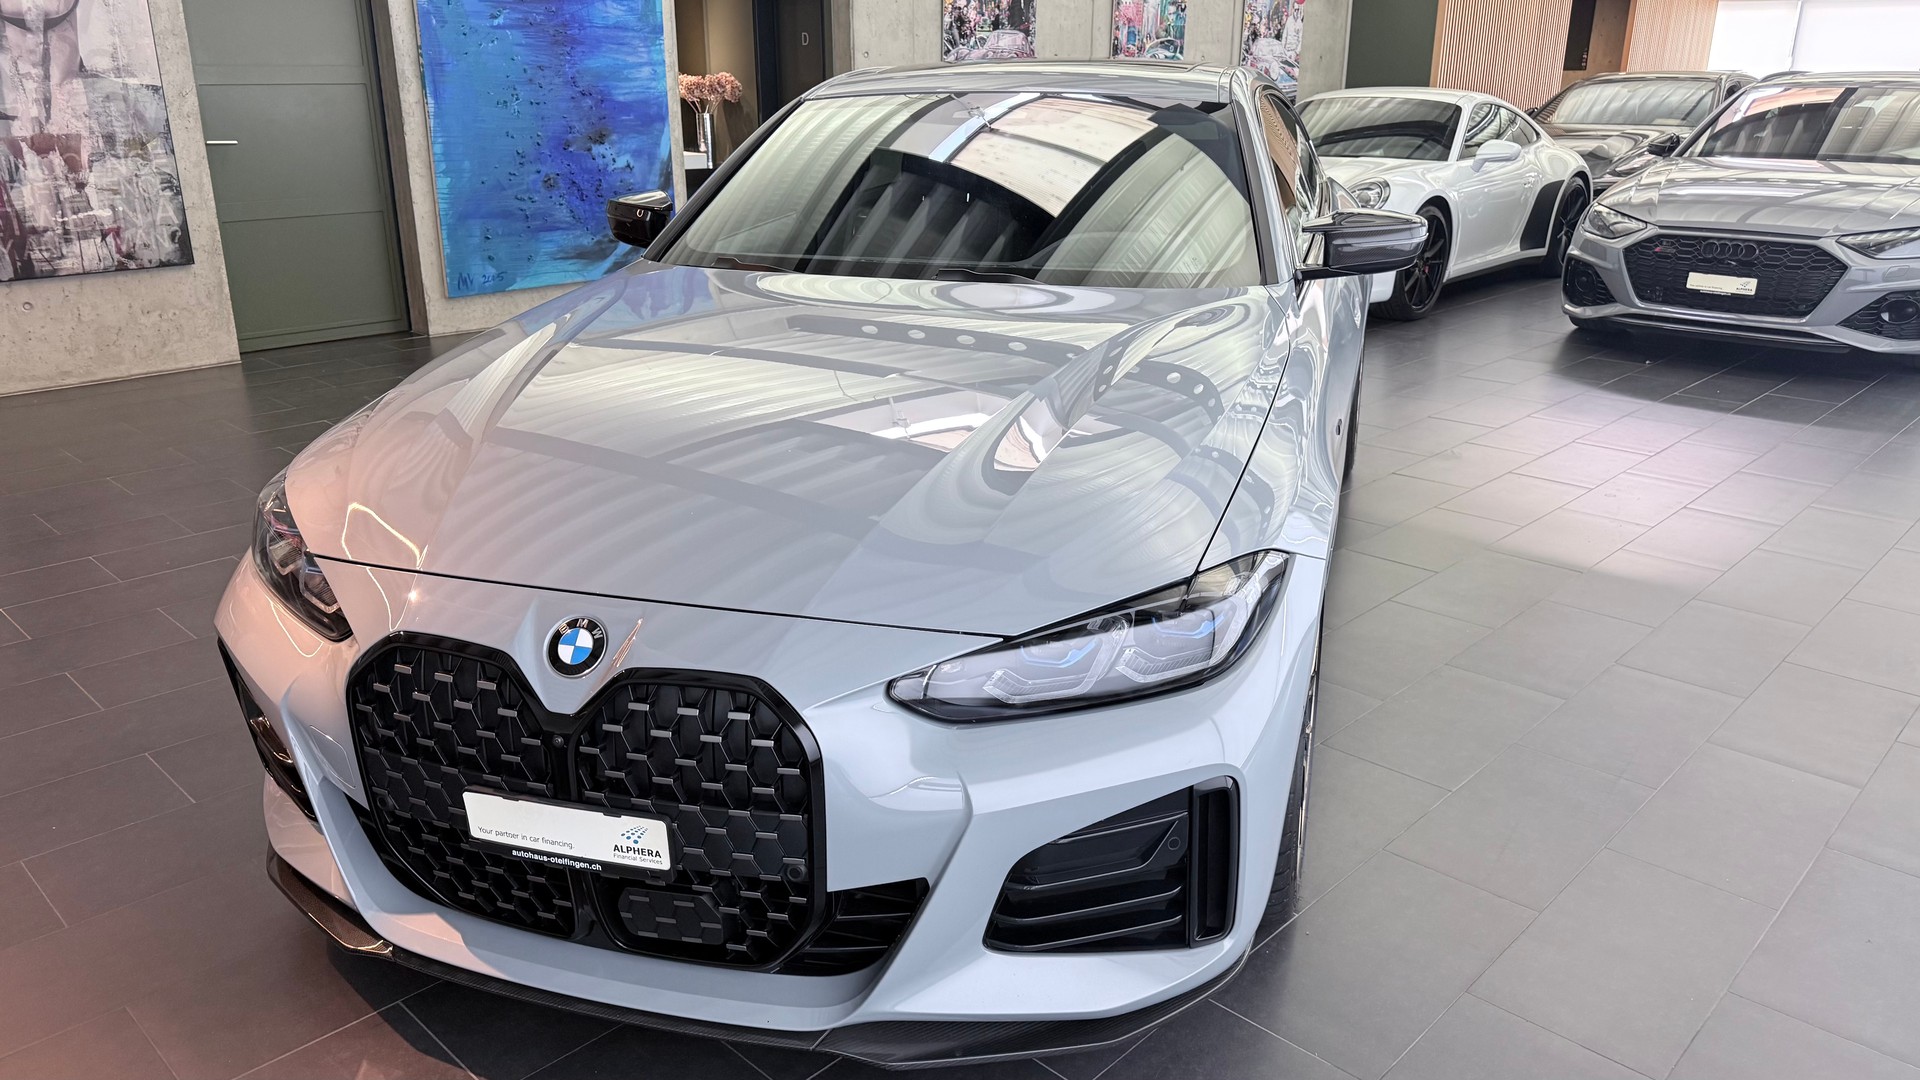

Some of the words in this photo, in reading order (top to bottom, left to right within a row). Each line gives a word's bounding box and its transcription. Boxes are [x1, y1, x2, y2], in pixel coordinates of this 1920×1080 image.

[801, 32, 809, 46] D
[558, 618, 604, 640] BMW
[477, 826, 493, 835] Your
[494, 830, 519, 840] partner
[520, 833, 528, 841] in
[541, 837, 575, 850] financing.
[511, 849, 602, 871] autohaus-otelfingen.ch
[613, 844, 662, 859] ALPHERA
[613, 852, 638, 862] Financial
[639, 855, 663, 865] Services
